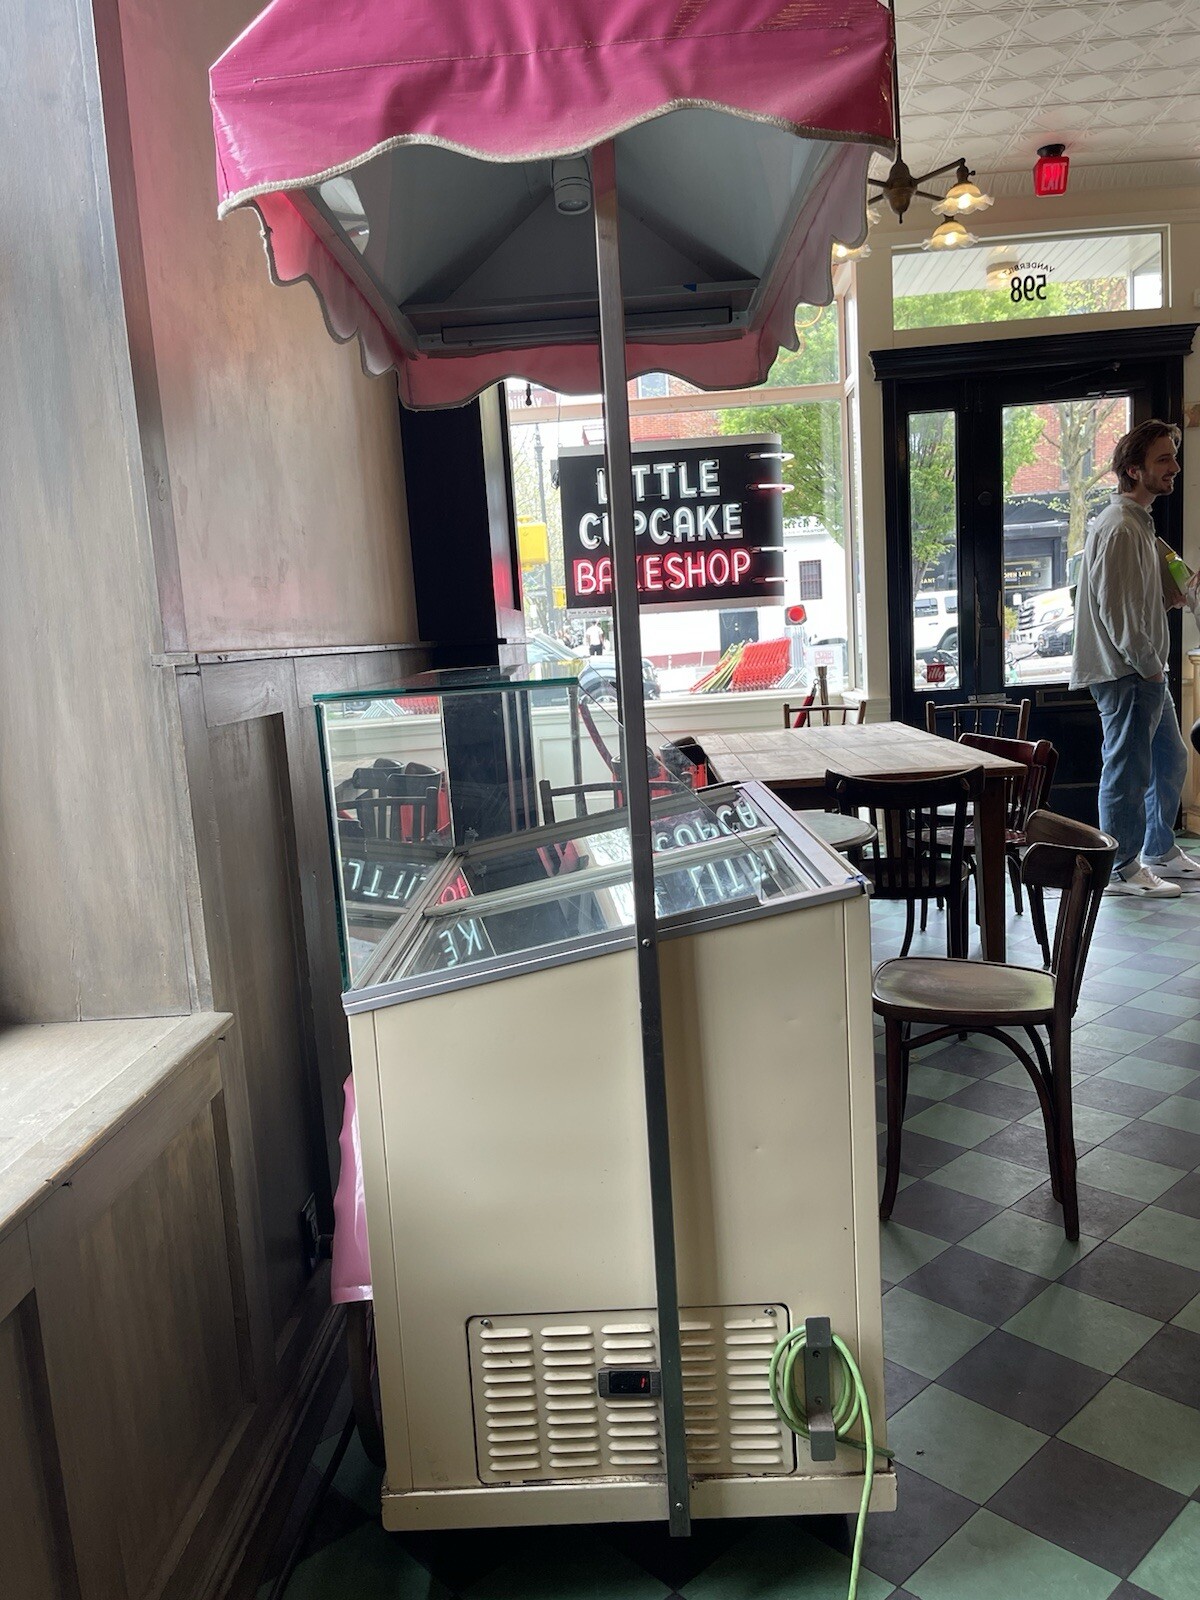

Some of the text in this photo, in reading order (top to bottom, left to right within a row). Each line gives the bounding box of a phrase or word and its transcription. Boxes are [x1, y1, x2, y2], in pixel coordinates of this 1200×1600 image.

[1041, 162, 1067, 191] EXIT
[596, 459, 720, 504] LTTLE
[579, 502, 743, 550] CPCAKE
[573, 548, 750, 595] BAESHOP
[928, 666, 945, 680] illy
